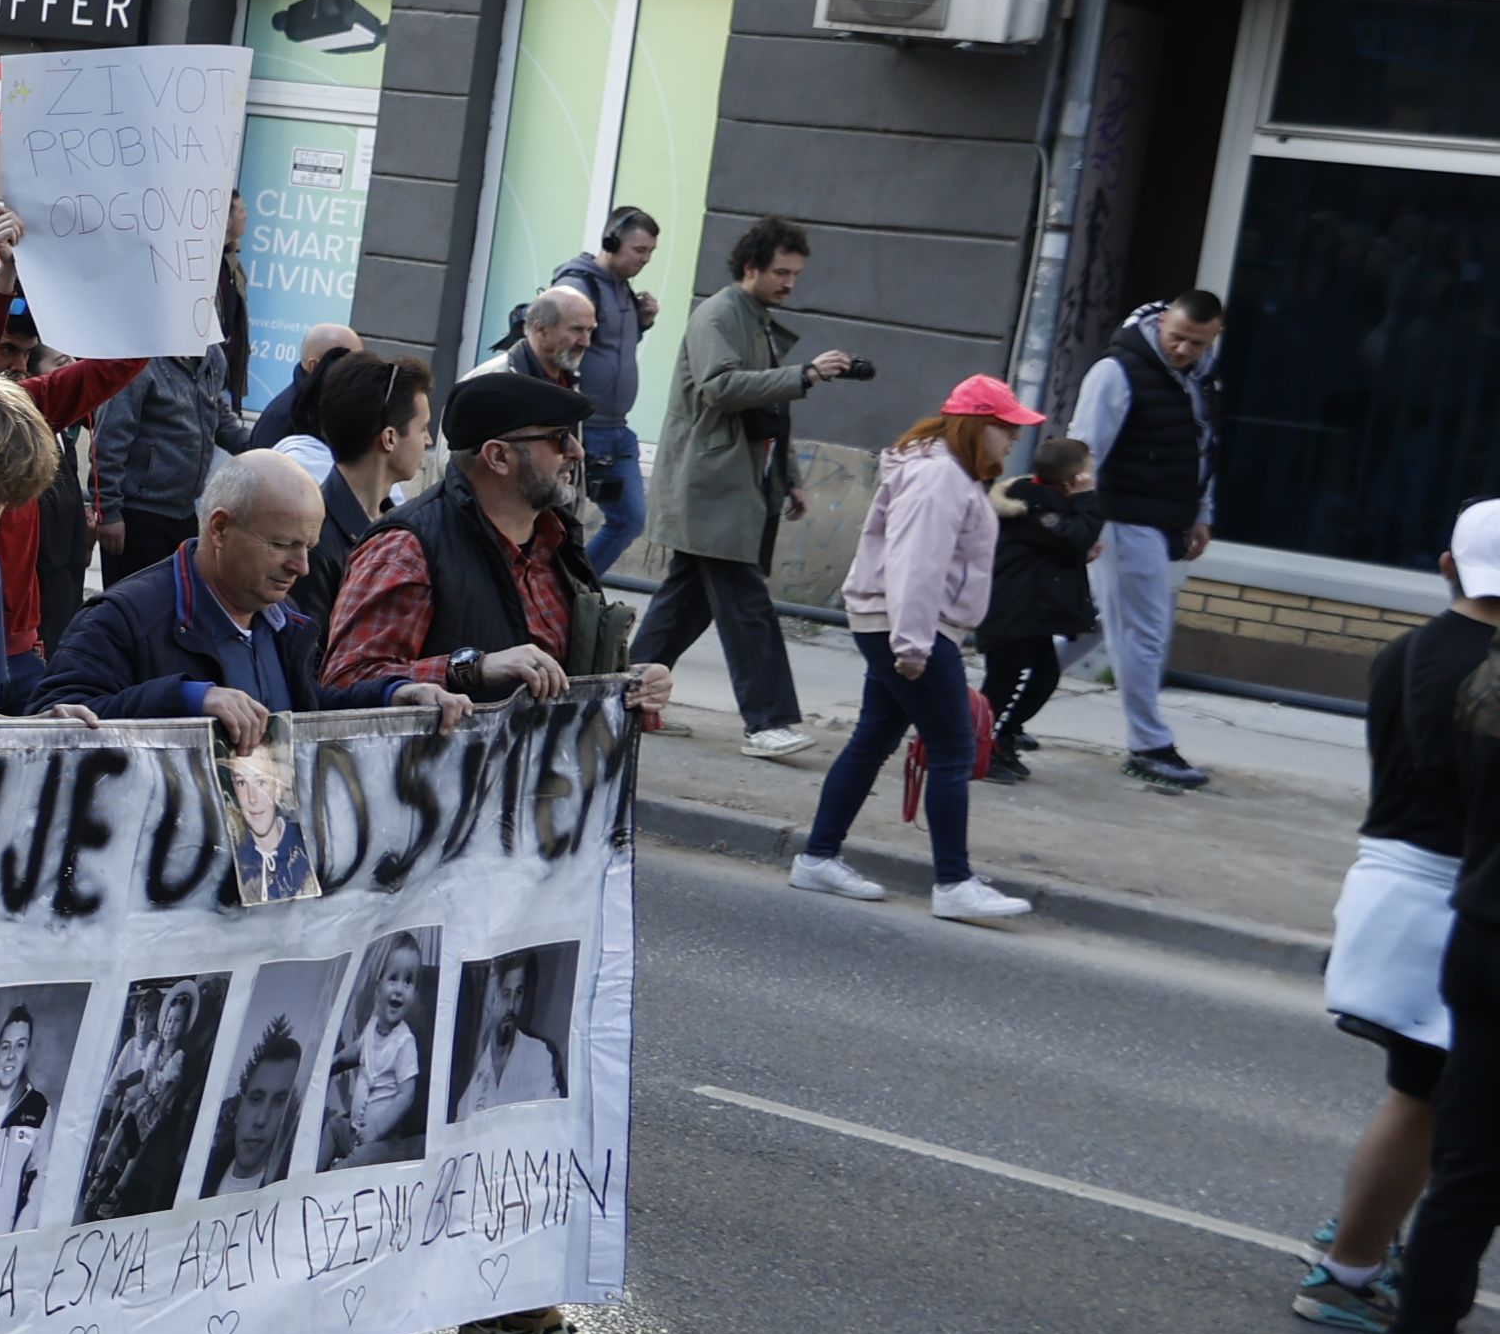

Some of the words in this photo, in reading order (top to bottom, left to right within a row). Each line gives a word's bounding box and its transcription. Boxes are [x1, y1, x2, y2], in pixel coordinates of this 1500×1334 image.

[45, 59, 235, 115] ŽIVOT
[23, 125, 209, 176] PROBNA
[256, 189, 367, 227] CLIVET
[252, 225, 362, 264] SMART
[249, 259, 356, 299] LIVING
[43, 1226, 151, 1318] ESMA
[171, 1201, 280, 1292] ADEM
